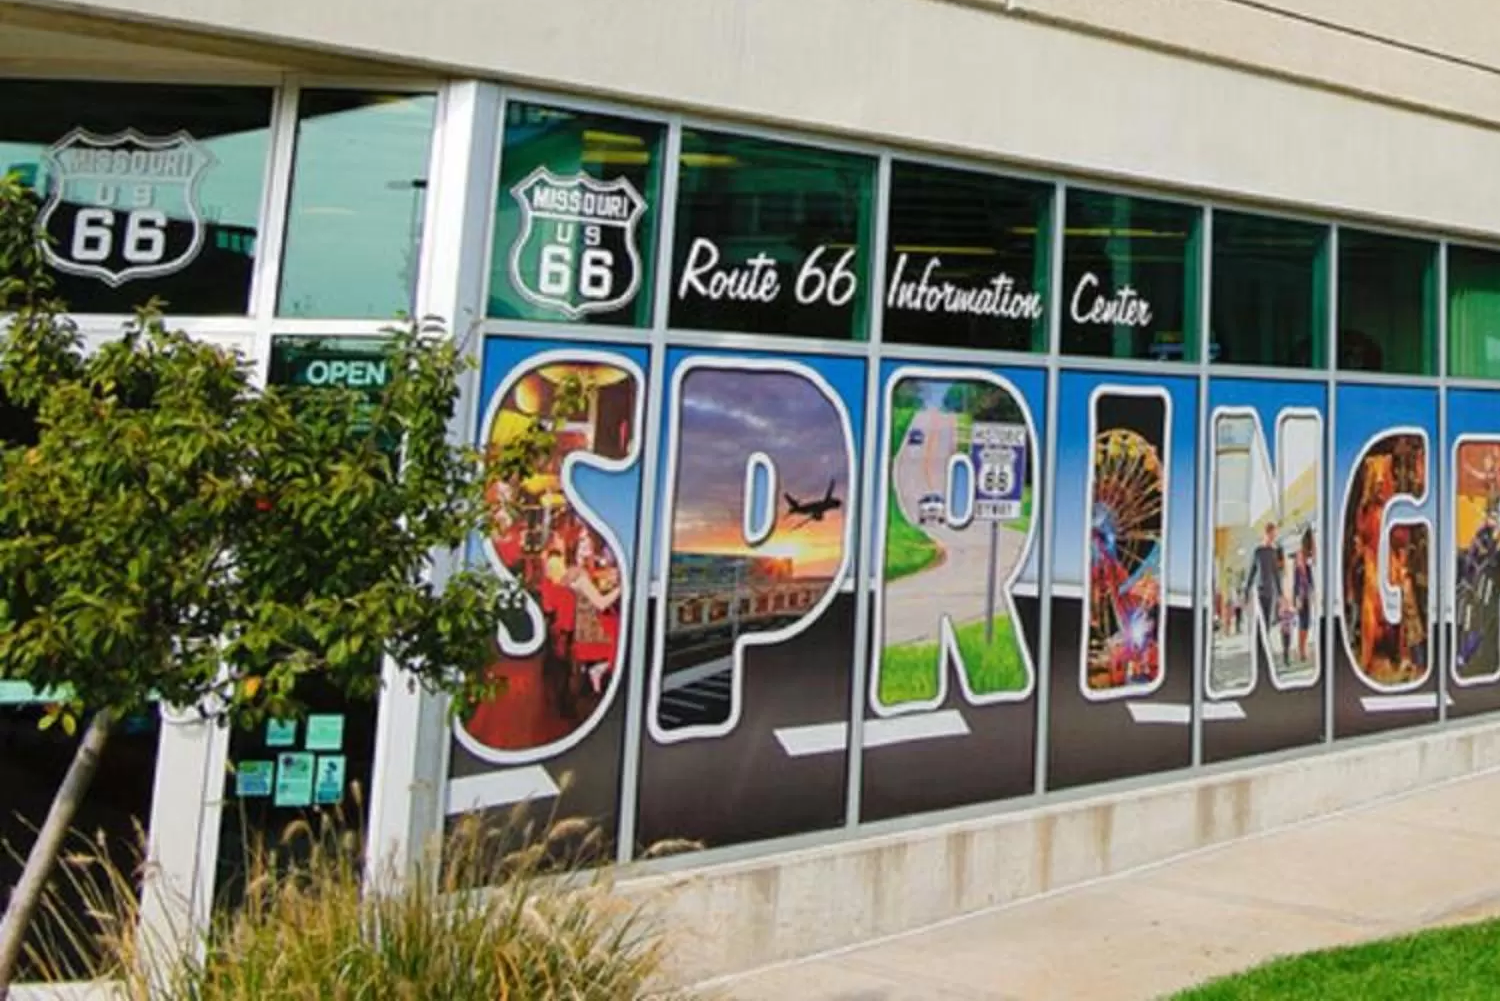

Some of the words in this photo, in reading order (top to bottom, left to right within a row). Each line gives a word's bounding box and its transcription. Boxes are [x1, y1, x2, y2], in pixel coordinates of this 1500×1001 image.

[71, 148, 193, 176] MISSOURI
[532, 185, 628, 218] MISSOURI
[71, 208, 168, 262] 66
[539, 245, 614, 299] 66
[678, 238, 780, 303] Route
[793, 244, 857, 307] 66
[887, 253, 1042, 321] Information
[1069, 272, 1153, 327] Center
[306, 360, 386, 385] OPEN
